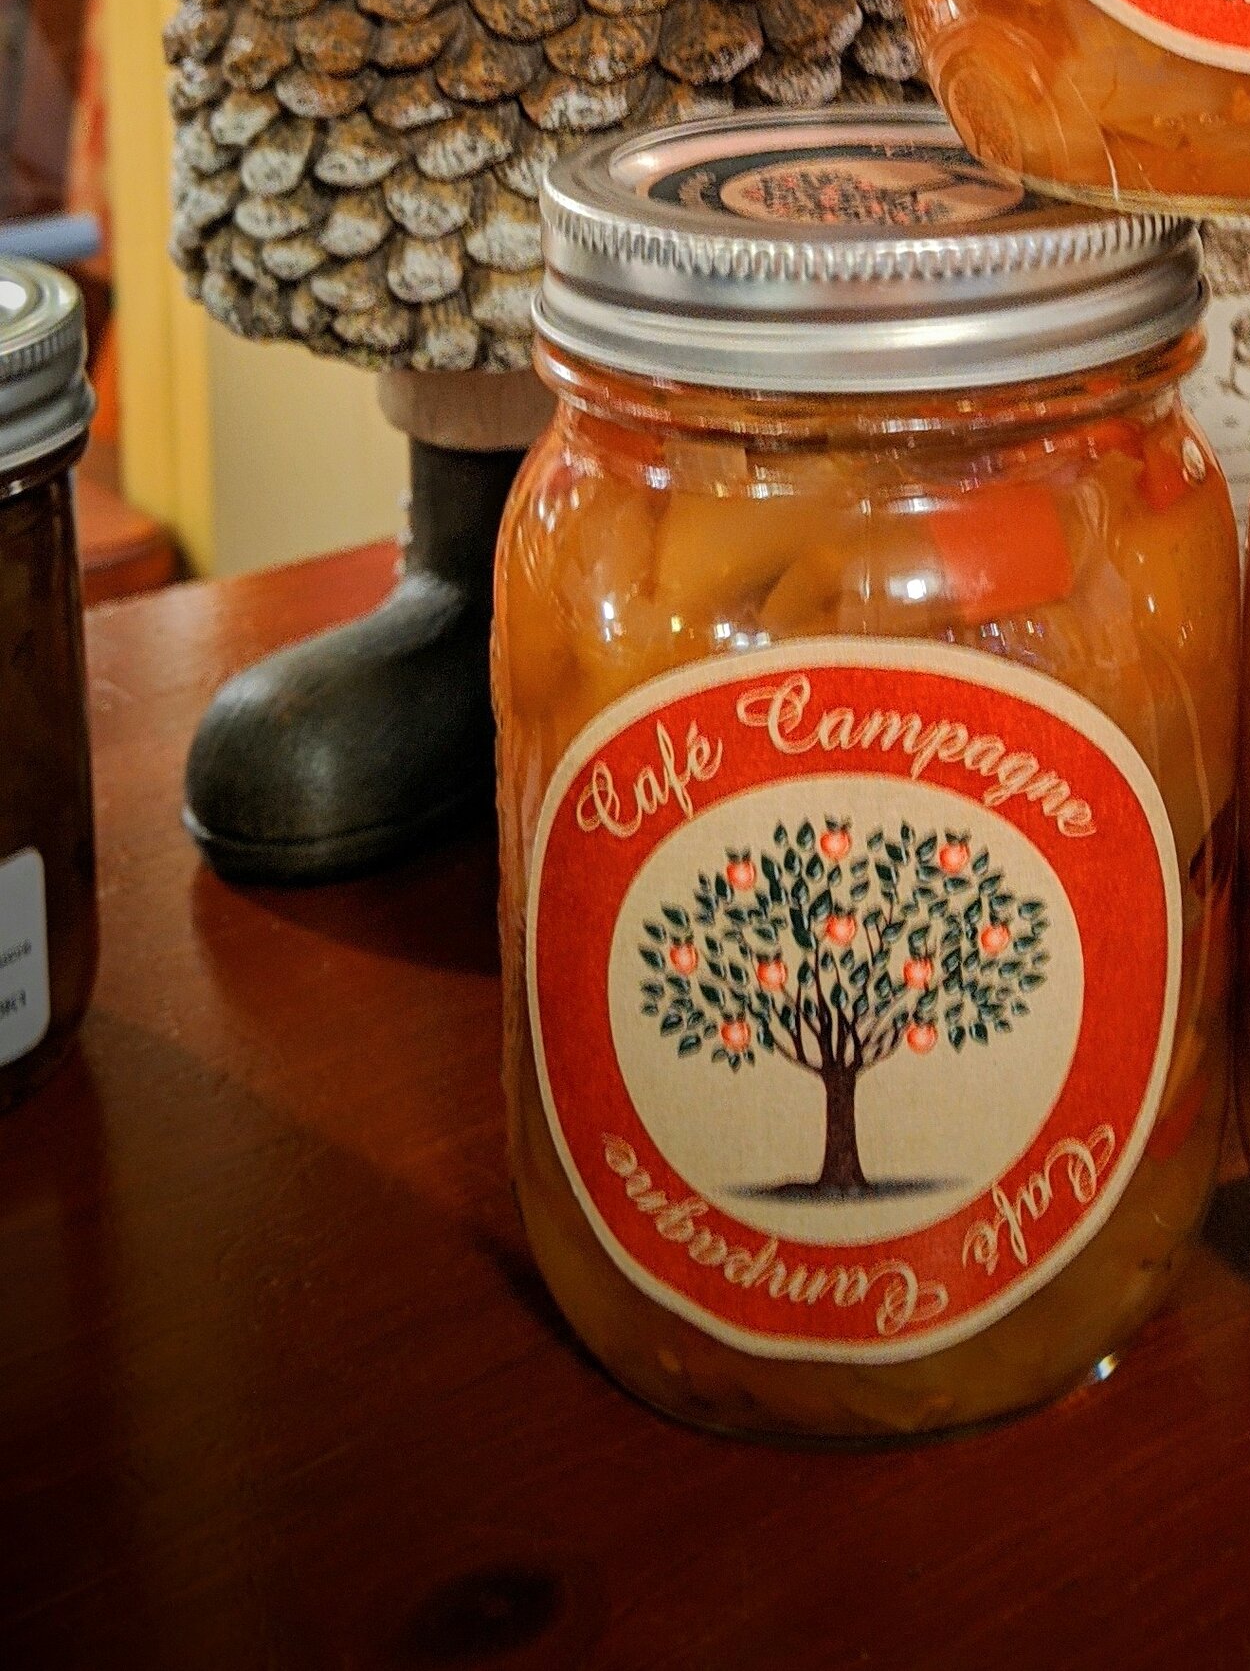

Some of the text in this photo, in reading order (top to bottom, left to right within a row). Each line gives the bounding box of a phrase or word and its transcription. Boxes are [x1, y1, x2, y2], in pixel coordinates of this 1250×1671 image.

[576, 672, 1097, 840] Café Campagne
[602, 1123, 1116, 1336] Café Campagne
